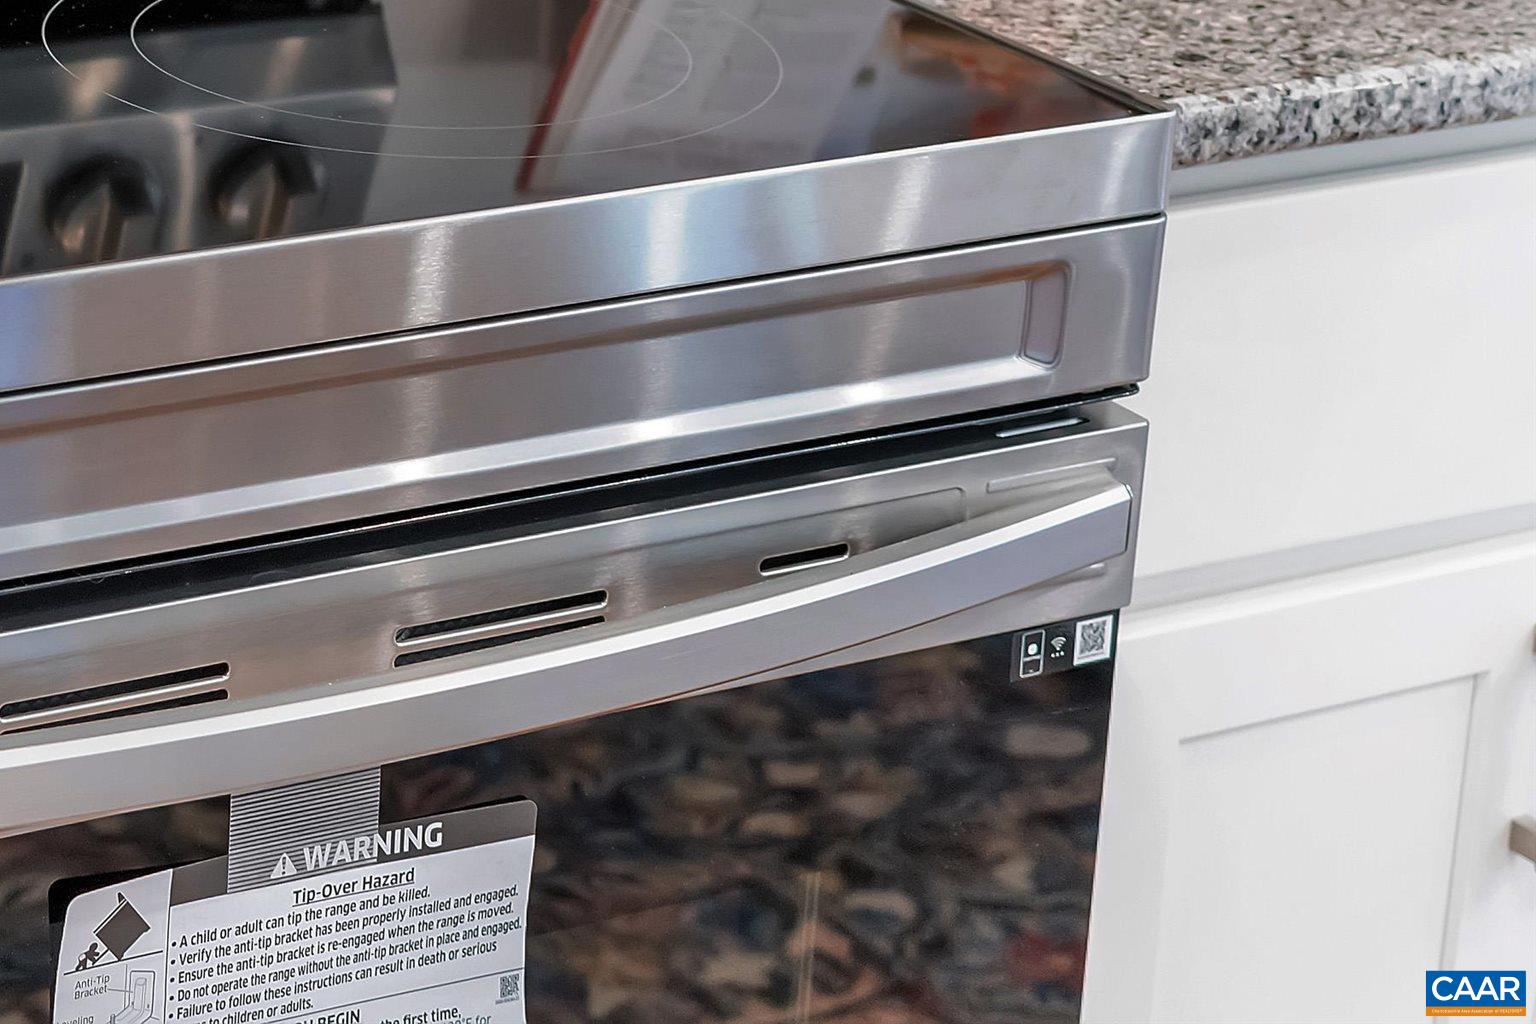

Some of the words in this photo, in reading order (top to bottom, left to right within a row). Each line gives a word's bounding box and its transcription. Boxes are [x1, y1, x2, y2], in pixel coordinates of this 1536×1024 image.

[304, 822, 443, 872] WARNING
[293, 880, 358, 905] Tip-Over
[362, 867, 414, 890] Hazard
[179, 948, 212, 966] Verify
[214, 945, 232, 958] the
[234, 936, 272, 954] anti-tip
[274, 927, 312, 946] bracket
[316, 924, 332, 936] has
[336, 918, 360, 933] been
[362, 908, 406, 930] properly
[409, 898, 451, 918] installed
[454, 894, 472, 908] and
[474, 884, 518, 904] engaged.
[180, 935, 188, 948] A
[191, 928, 217, 945] child
[220, 927, 232, 940] or
[235, 919, 263, 936] adult
[266, 916, 284, 930] can
[288, 911, 302, 926] tip
[305, 908, 322, 922] the
[325, 902, 356, 917] range
[360, 895, 379, 910] and
[382, 893, 396, 906] be
[399, 886, 430, 904] killed.
[178, 968, 214, 984] Ensure
[217, 962, 234, 976] the
[236, 953, 274, 972] anti-tip
[276, 944, 314, 963] bracket
[318, 942, 326, 954] is
[328, 928, 385, 952] re-engaged
[388, 924, 415, 939] when
[418, 919, 434, 932] the
[436, 914, 464, 929] range
[468, 910, 476, 922] is
[478, 902, 514, 920] moved.
[178, 990, 190, 1002] Do
[194, 982, 209, 997] not
[212, 977, 248, 996] operate
[251, 973, 266, 986] the
[268, 967, 296, 983] range
[298, 956, 334, 976] without
[336, 954, 350, 967] the
[353, 946, 386, 964] anti-tip
[388, 938, 424, 956] bracket
[426, 936, 434, 948] in
[436, 931, 460, 948] place
[462, 926, 479, 940] and
[482, 917, 522, 936] engaged.
[74, 975, 110, 990] Anti-Tip
[74, 985, 108, 1000] Bracket
[177, 1002, 212, 1019] Failure
[216, 998, 226, 1011] to
[229, 992, 262, 1010] follow
[264, 986, 292, 1001] these
[294, 971, 352, 994] instructions
[355, 968, 372, 980] can
[374, 959, 404, 976] result
[406, 956, 416, 970] in
[418, 950, 446, 967] death
[448, 948, 459, 960] or
[462, 940, 497, 958] serious
[222, 1010, 264, 1024] children
[266, 1005, 278, 1018] or
[280, 998, 313, 1015] adults.
[403, 1012, 428, 1024] first
[431, 1008, 462, 1022] time,
